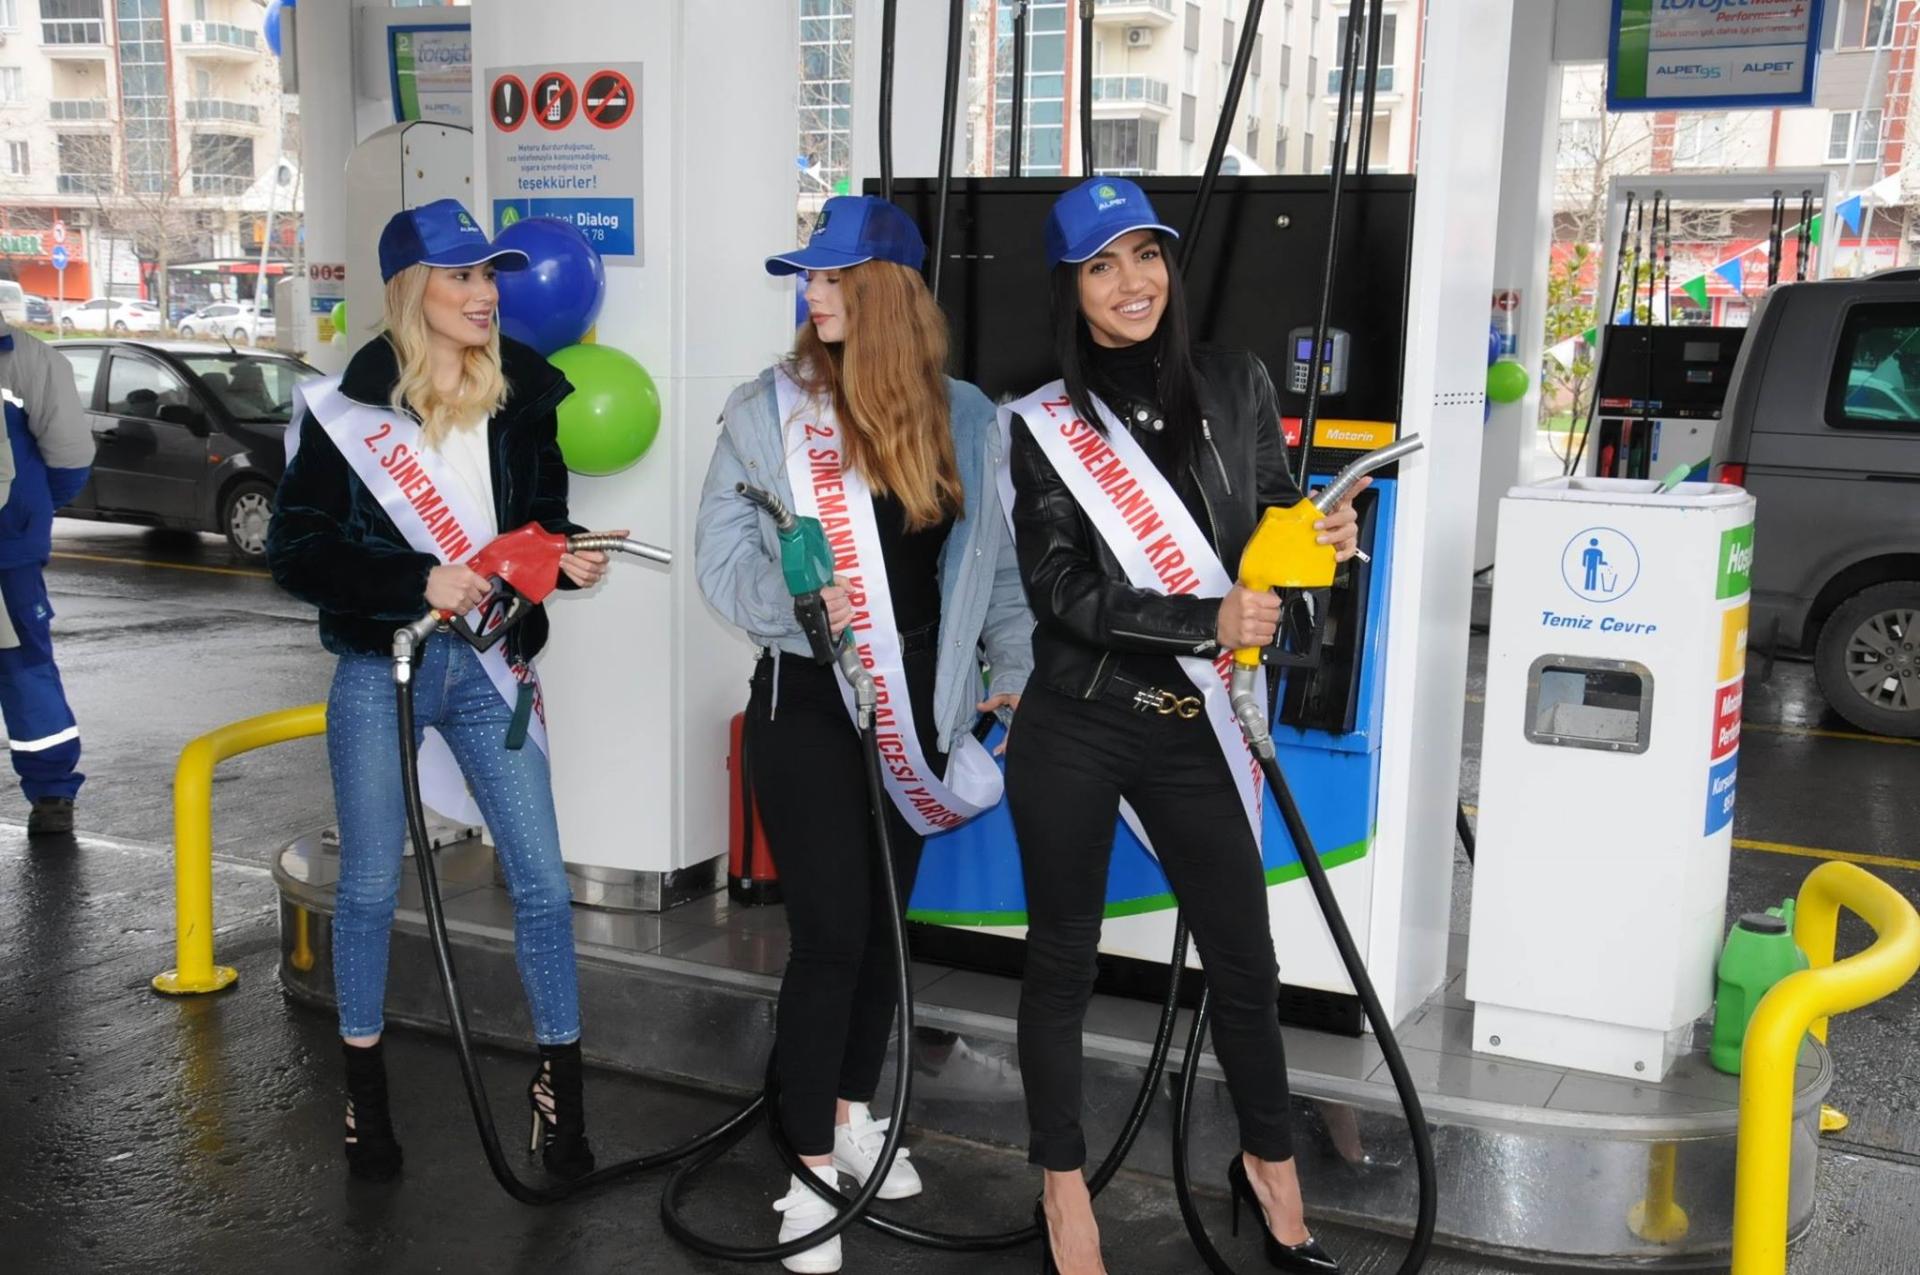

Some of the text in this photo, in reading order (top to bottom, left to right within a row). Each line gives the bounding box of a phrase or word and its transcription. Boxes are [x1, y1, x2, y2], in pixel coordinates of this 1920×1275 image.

[1742, 61, 1794, 72] ALPET
[518, 174, 597, 190] teşekkürler!
[577, 212, 619, 229] Dialog
[591, 229, 605, 240] 78
[1041, 395, 1072, 418] 2.
[804, 423, 834, 441] 2.
[1326, 428, 1374, 442] Motorin
[364, 423, 472, 562] 2. SİNEMANIN
[1541, 611, 1593, 629] Temiz
